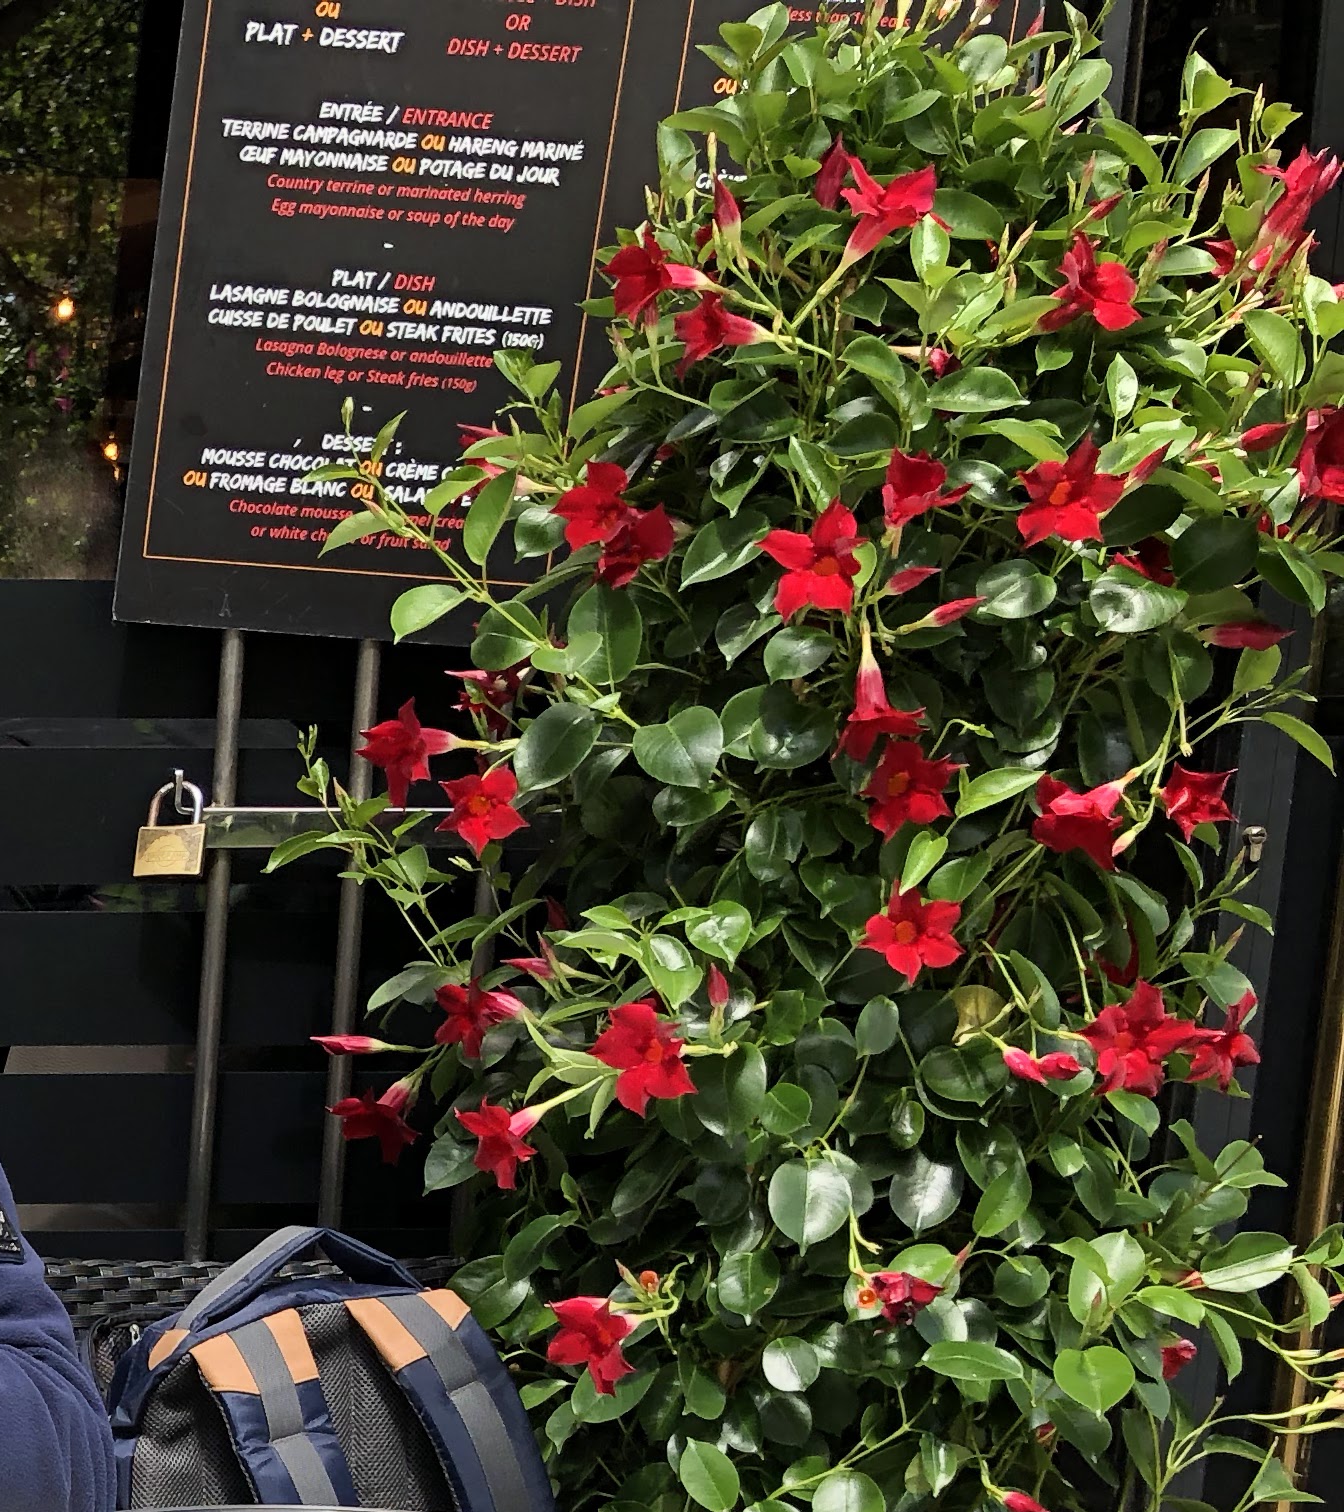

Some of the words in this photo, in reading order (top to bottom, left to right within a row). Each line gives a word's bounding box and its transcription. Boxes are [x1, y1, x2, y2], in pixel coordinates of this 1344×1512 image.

[315, 1, 340, 19] OU
[505, 14, 531, 31] OR
[245, 21, 299, 46] PLAT
[319, 27, 405, 54] DESSERT
[447, 37, 490, 57] DISH
[507, 42, 583, 63] DESSERT
[319, 101, 384, 124] ENTRÉE
[401, 107, 494, 130] ENTRANCE
[222, 118, 290, 140] TERRINE
[292, 125, 417, 151] CAMPAGNARDE
[420, 133, 445, 152] OU
[448, 135, 518, 157] HARENG
[520, 139, 584, 161] MARINÉ
[279, 148, 390, 172] MAYONNAISE
[392, 156, 416, 174] OU
[419, 160, 486, 180] POTAGE
[489, 164, 514, 181] DU
[516, 165, 561, 187] JOUR
[267, 174, 323, 194] Country
[326, 179, 374, 196] terrine
[397, 184, 471, 202] marinated
[474, 189, 526, 209] herring
[270, 198, 296, 217] Egg
[299, 203, 384, 222] mayonnaise
[407, 211, 441, 227] soup
[487, 214, 515, 232] day
[331, 269, 377, 290] PLAT
[394, 273, 436, 292] DISH
[209, 284, 289, 306] LASAGNE
[291, 289, 400, 314] BOLOGNAISE
[403, 299, 427, 317] OU
[429, 300, 553, 326] ANDOUILLETTE
[207, 308, 264, 328] CUISSE
[266, 312, 290, 329] DE
[292, 314, 357, 337] POULET
[359, 319, 383, 337] OU
[386, 321, 441, 342] STEAK
[442, 325, 497, 347] FRITES
[255, 338, 314, 356] Lasagna
[316, 341, 388, 361] Bolognese
[409, 350, 494, 369] andouillette
[266, 361, 321, 380] Chicken
[324, 365, 345, 384] leg
[366, 368, 405, 386] Steak
[405, 371, 440, 390] fries
[201, 448, 265, 468] MOUSSE
[385, 458, 438, 481] CRÈME
[183, 470, 206, 488] OU
[209, 472, 286, 497] FROMAGE
[289, 480, 347, 498] BLANC
[351, 483, 374, 499] OU
[230, 500, 297, 518] Chocolate
[269, 525, 308, 541] white
